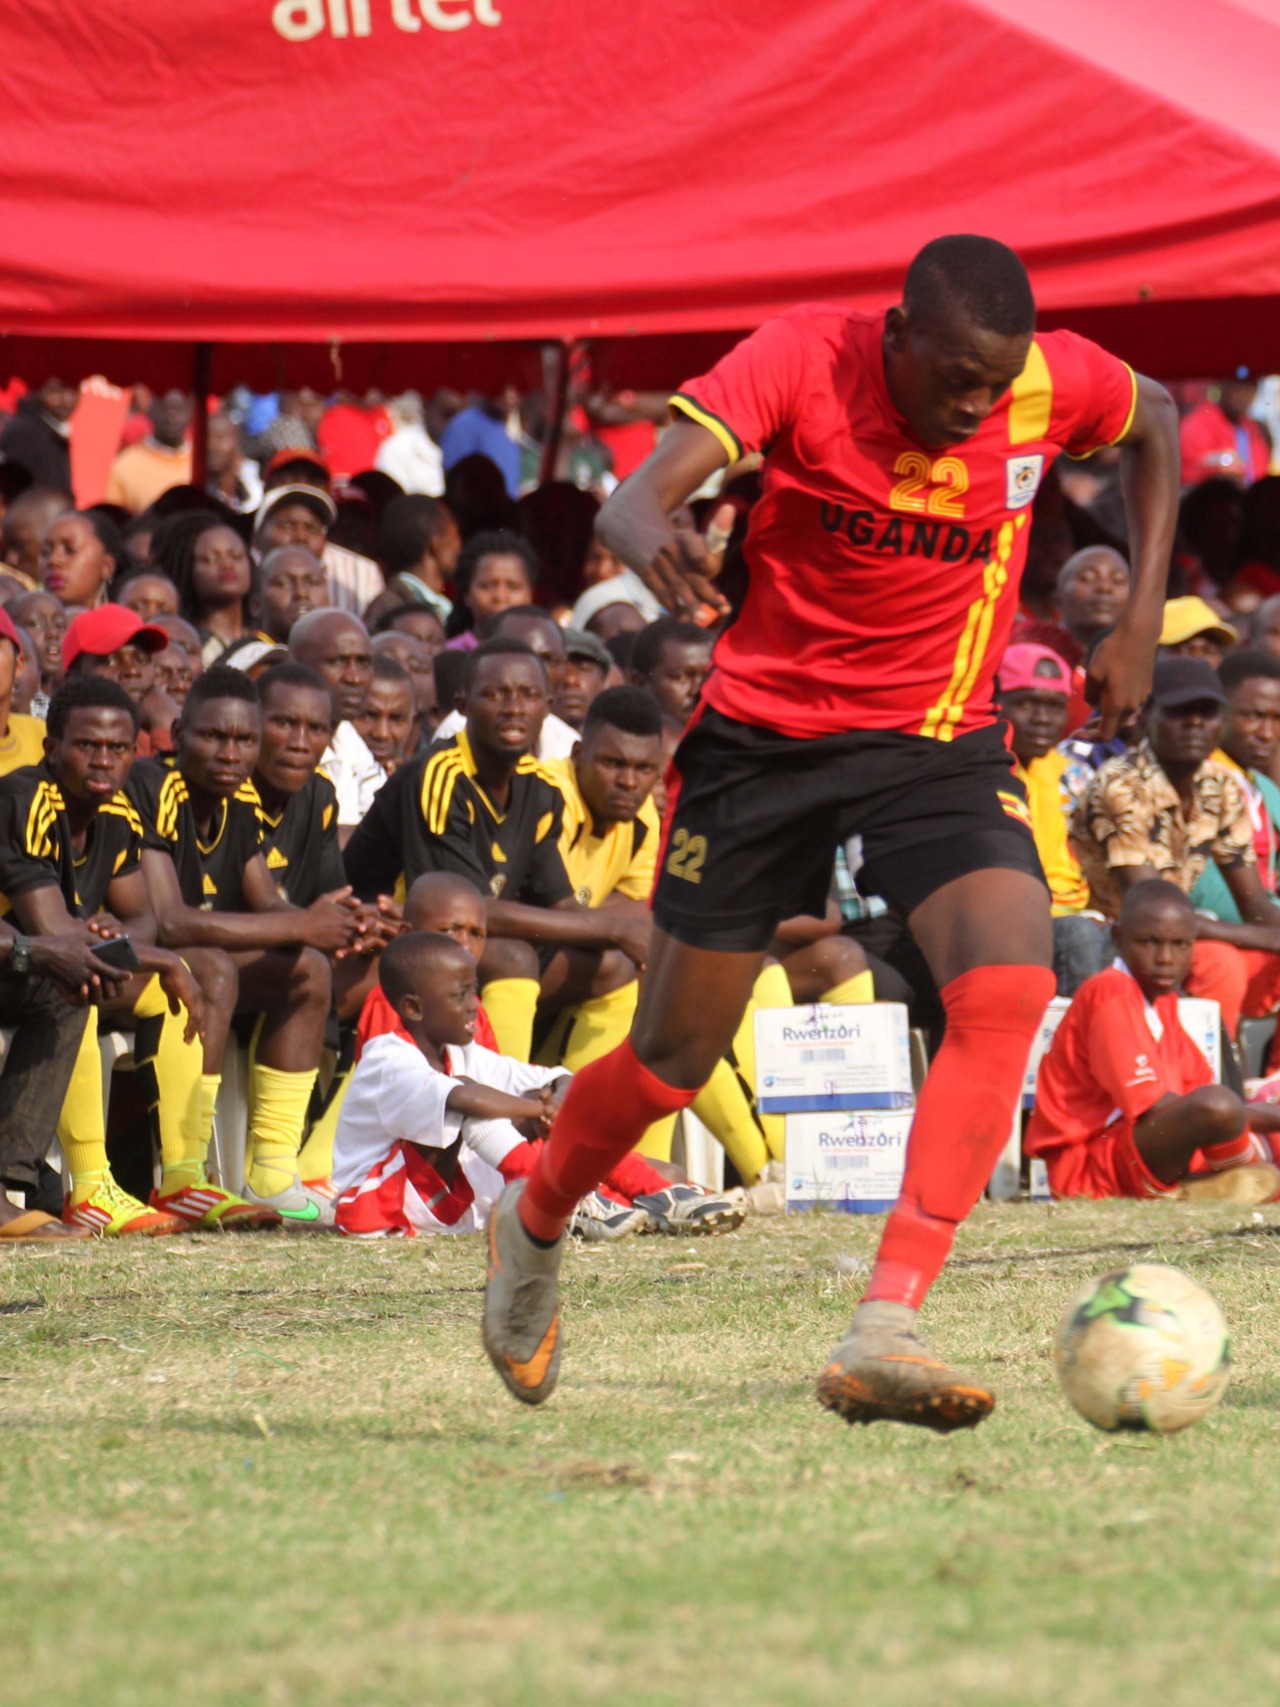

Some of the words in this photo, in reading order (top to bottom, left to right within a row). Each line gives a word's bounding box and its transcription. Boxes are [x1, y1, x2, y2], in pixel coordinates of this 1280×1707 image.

[890, 451, 970, 519] 22
[819, 501, 992, 565] UGANDA
[667, 828, 708, 884] 22
